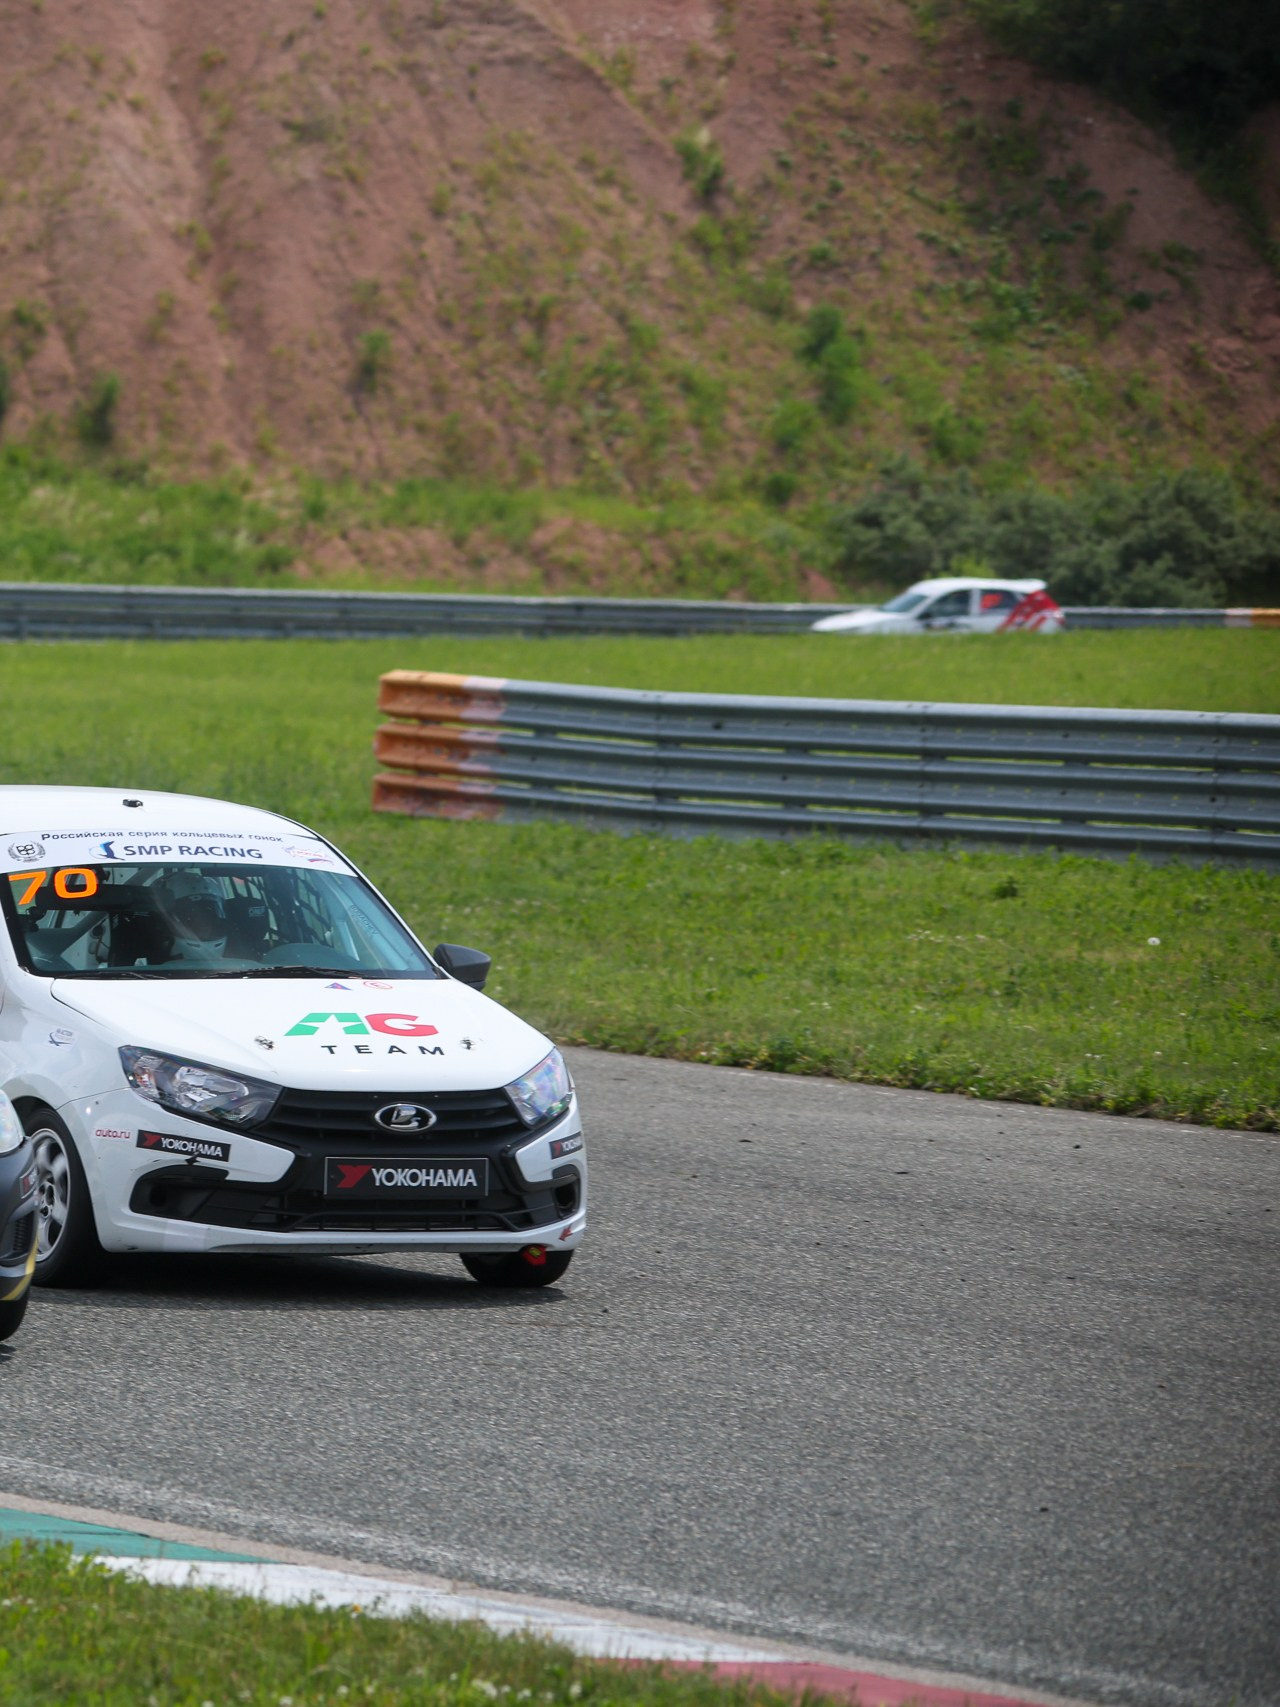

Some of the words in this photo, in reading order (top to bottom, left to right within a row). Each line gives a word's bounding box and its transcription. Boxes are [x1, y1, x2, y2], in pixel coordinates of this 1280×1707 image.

[41, 831, 124, 841] Российская
[128, 831, 168, 839] серия
[172, 831, 245, 839] кольцевых
[248, 834, 284, 843] гонок
[123, 845, 173, 856] SMP
[178, 845, 263, 859] RACING
[8, 867, 98, 906] 70
[321, 1044, 445, 1056] TEAM
[95, 1128, 131, 1139] auto.ru
[161, 1137, 223, 1157] YOKOHAMA
[371, 1168, 478, 1187] YOKOHAMA
